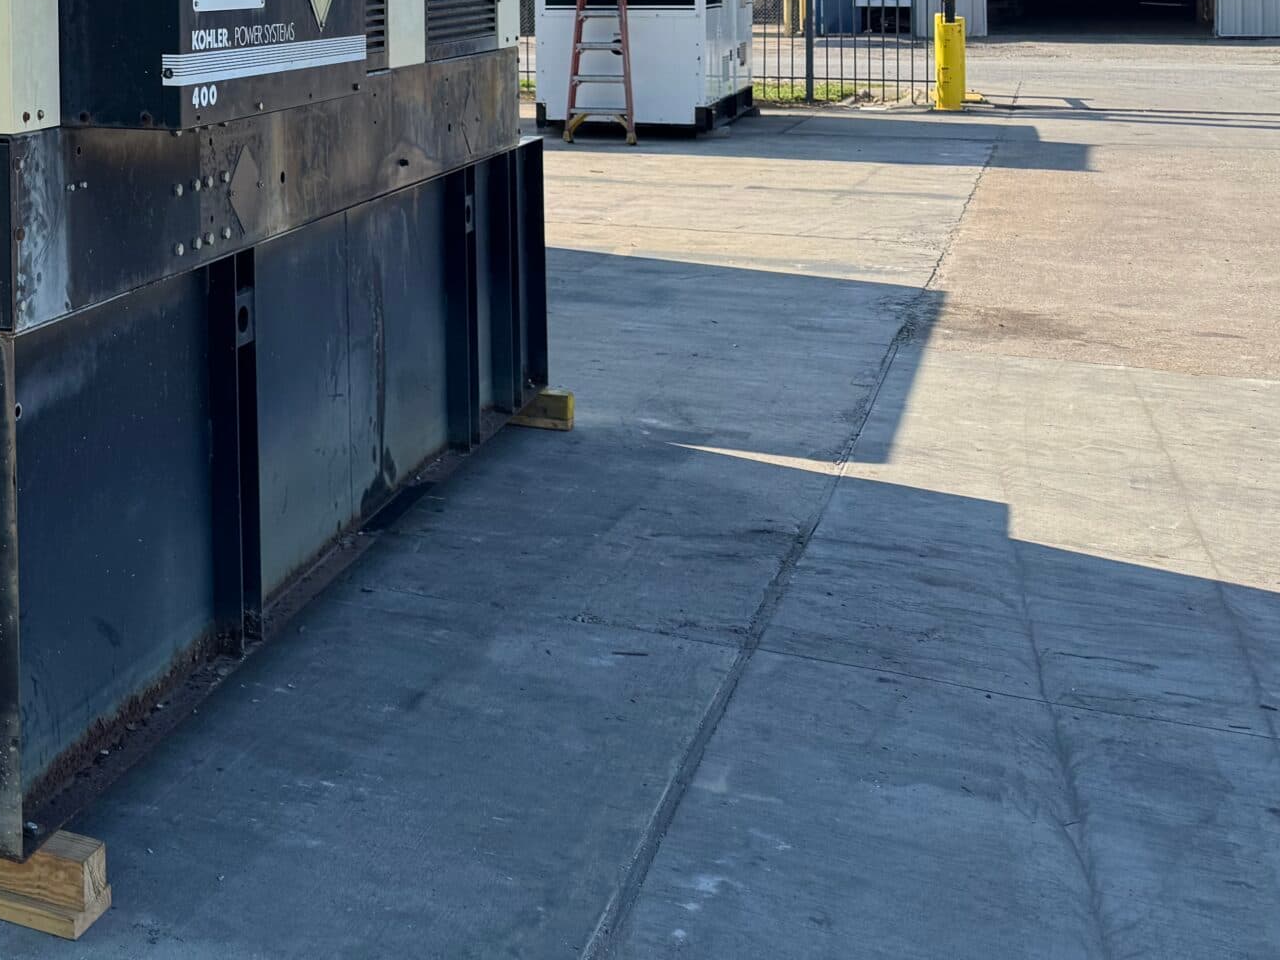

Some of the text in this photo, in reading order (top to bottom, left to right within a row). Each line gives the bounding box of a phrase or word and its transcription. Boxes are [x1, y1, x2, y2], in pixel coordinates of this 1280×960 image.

[192, 22, 295, 51] KOHLER POWER SYSTEMS
[192, 84, 218, 109] 400
